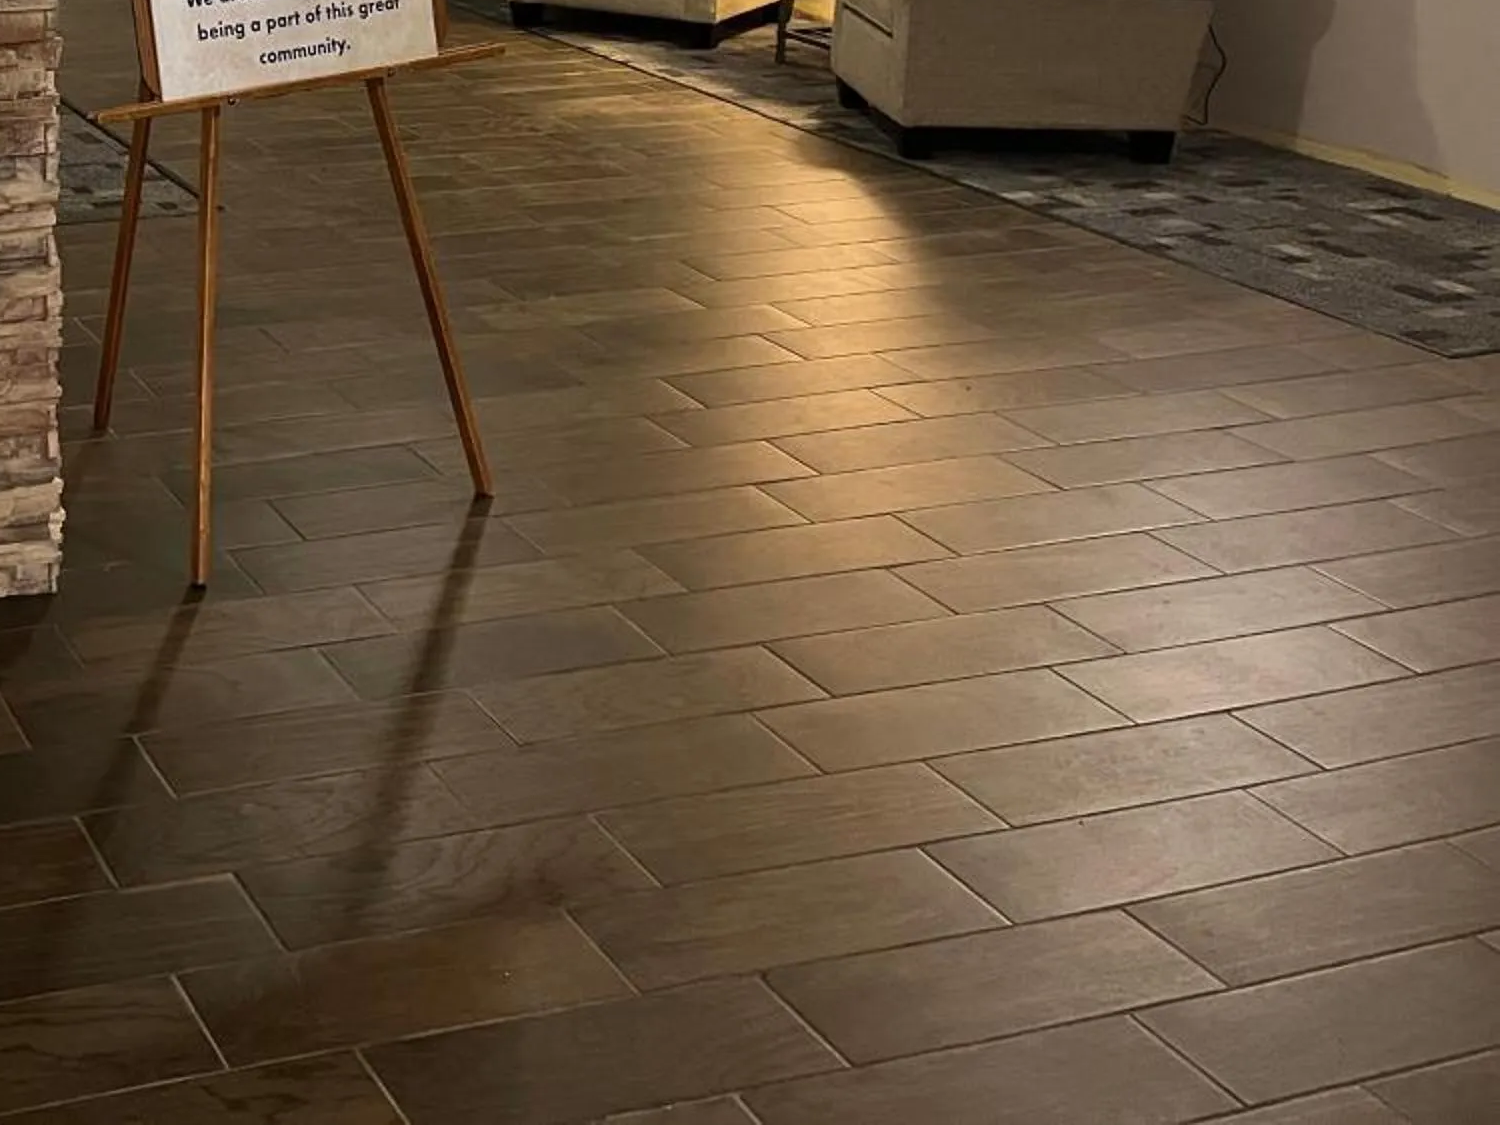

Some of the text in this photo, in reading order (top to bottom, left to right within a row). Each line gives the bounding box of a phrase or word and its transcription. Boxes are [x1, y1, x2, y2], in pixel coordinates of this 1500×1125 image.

[197, 23, 245, 42] being
[251, 18, 261, 31] a
[266, 11, 301, 35] part
[305, 6, 322, 24] of
[326, 0, 354, 21] this
[259, 36, 352, 65] community.
